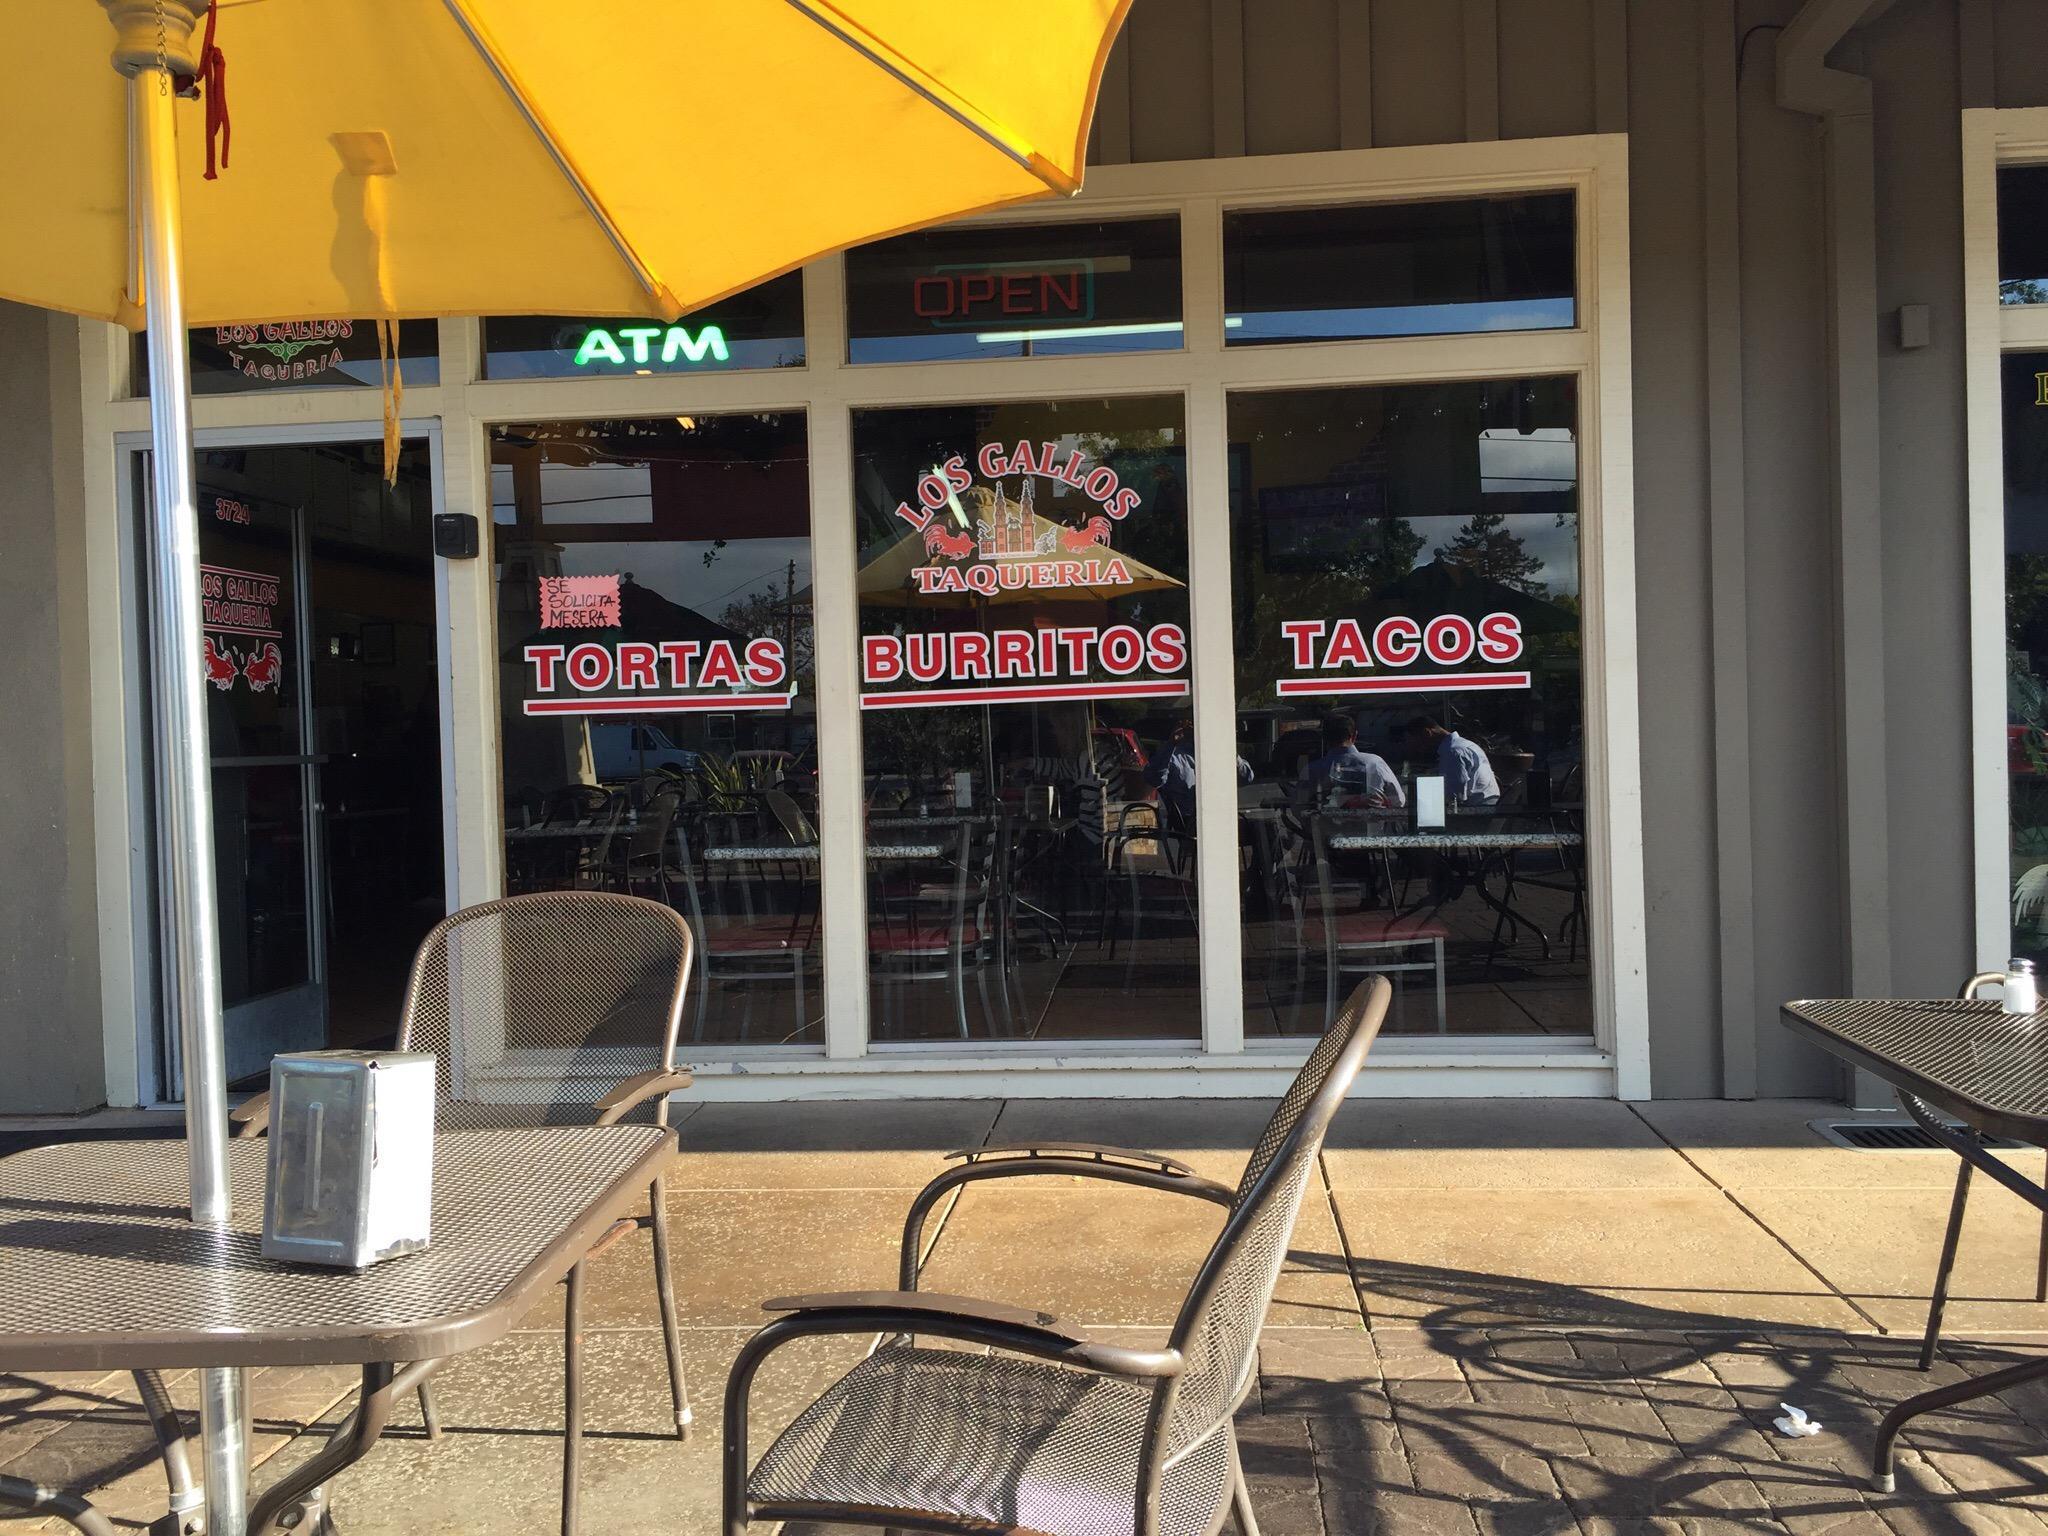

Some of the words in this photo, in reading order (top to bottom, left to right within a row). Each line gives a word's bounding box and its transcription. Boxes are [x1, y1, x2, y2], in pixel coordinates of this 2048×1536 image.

[914, 271, 1079, 317] OPEN
[216, 322, 259, 345] LOS
[263, 319, 353, 341] GALLOS
[574, 325, 730, 366] ATM
[229, 347, 344, 381] TAQUERIA
[895, 456, 972, 533] LOS
[978, 440, 1142, 520] GALLOS
[215, 498, 250, 525] 3724
[200, 573, 223, 599] OS
[226, 577, 278, 606] GALLOS
[546, 580, 570, 594] SE
[912, 559, 1133, 596] TAQUERIA
[203, 599, 272, 628] TAQUERIA
[548, 594, 615, 608] SOLICITA
[550, 609, 608, 626] MESERA
[862, 624, 1188, 684] BURRITOS
[1280, 612, 1524, 670] TACOS
[524, 638, 787, 692] TORTAS
